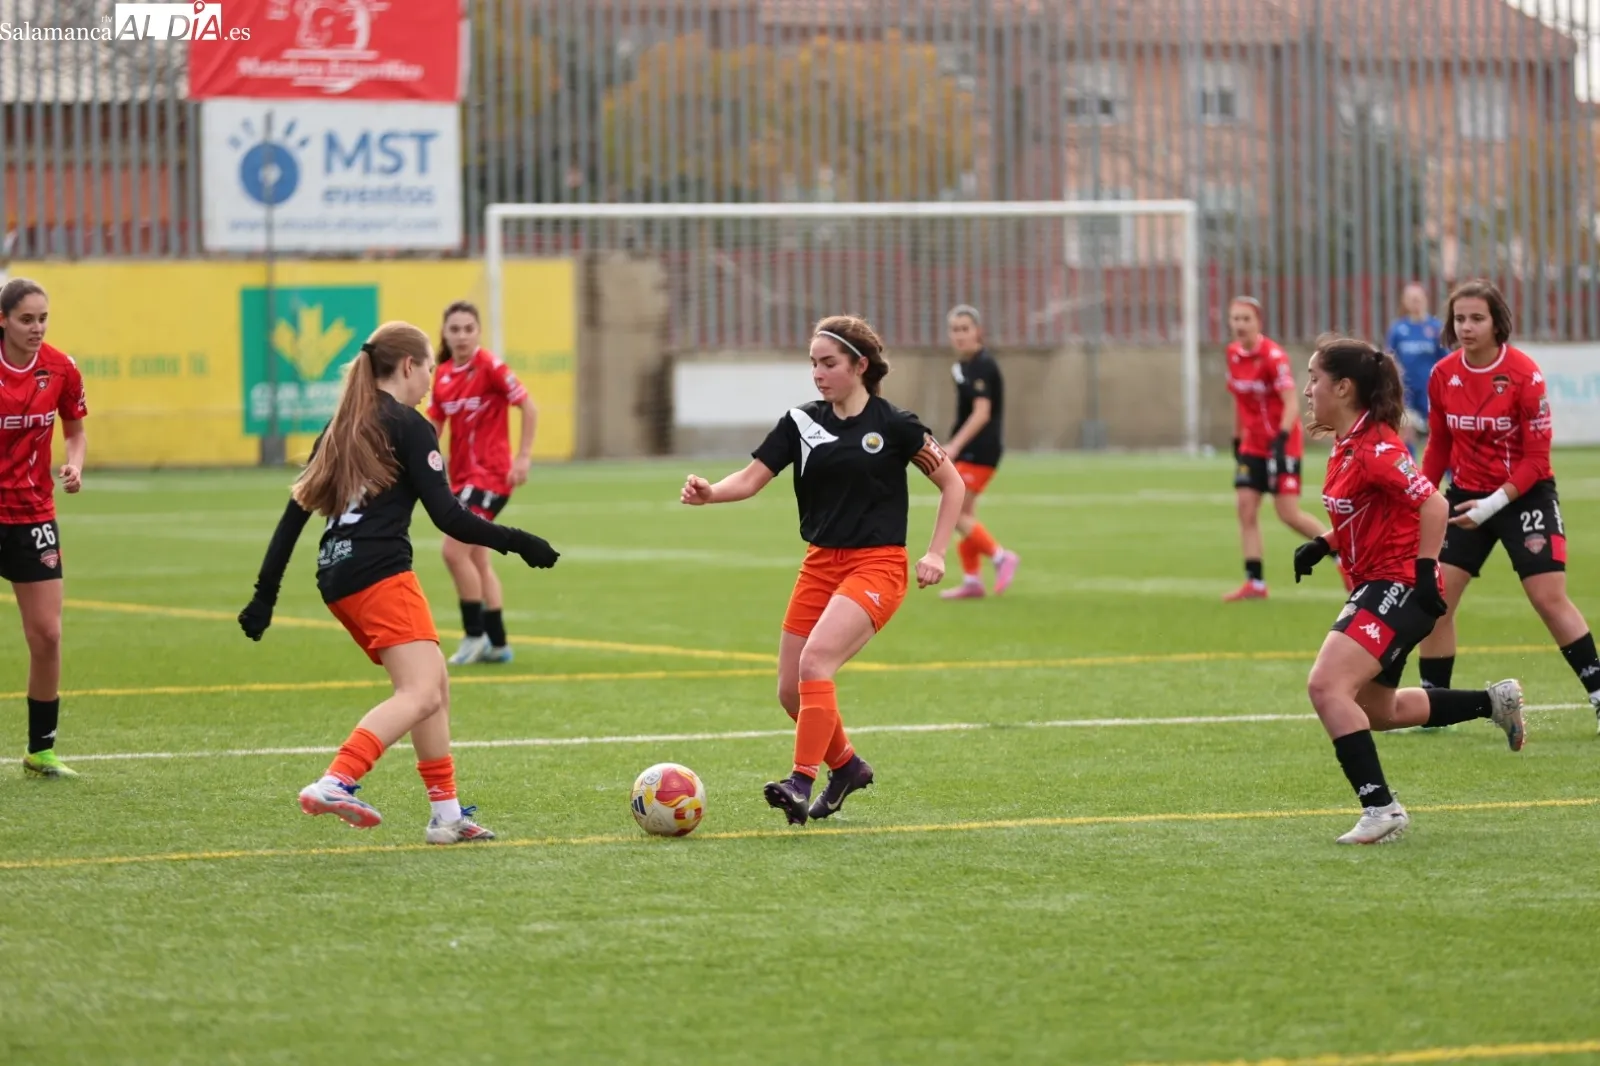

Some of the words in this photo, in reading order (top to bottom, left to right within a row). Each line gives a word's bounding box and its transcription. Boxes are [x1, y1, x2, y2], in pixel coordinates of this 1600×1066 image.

[323, 129, 439, 176] MST
[322, 184, 434, 206] eventos
[1446, 414, 1512, 431] MEINS
[1520, 509, 1545, 533] 22
[31, 522, 57, 550] 26
